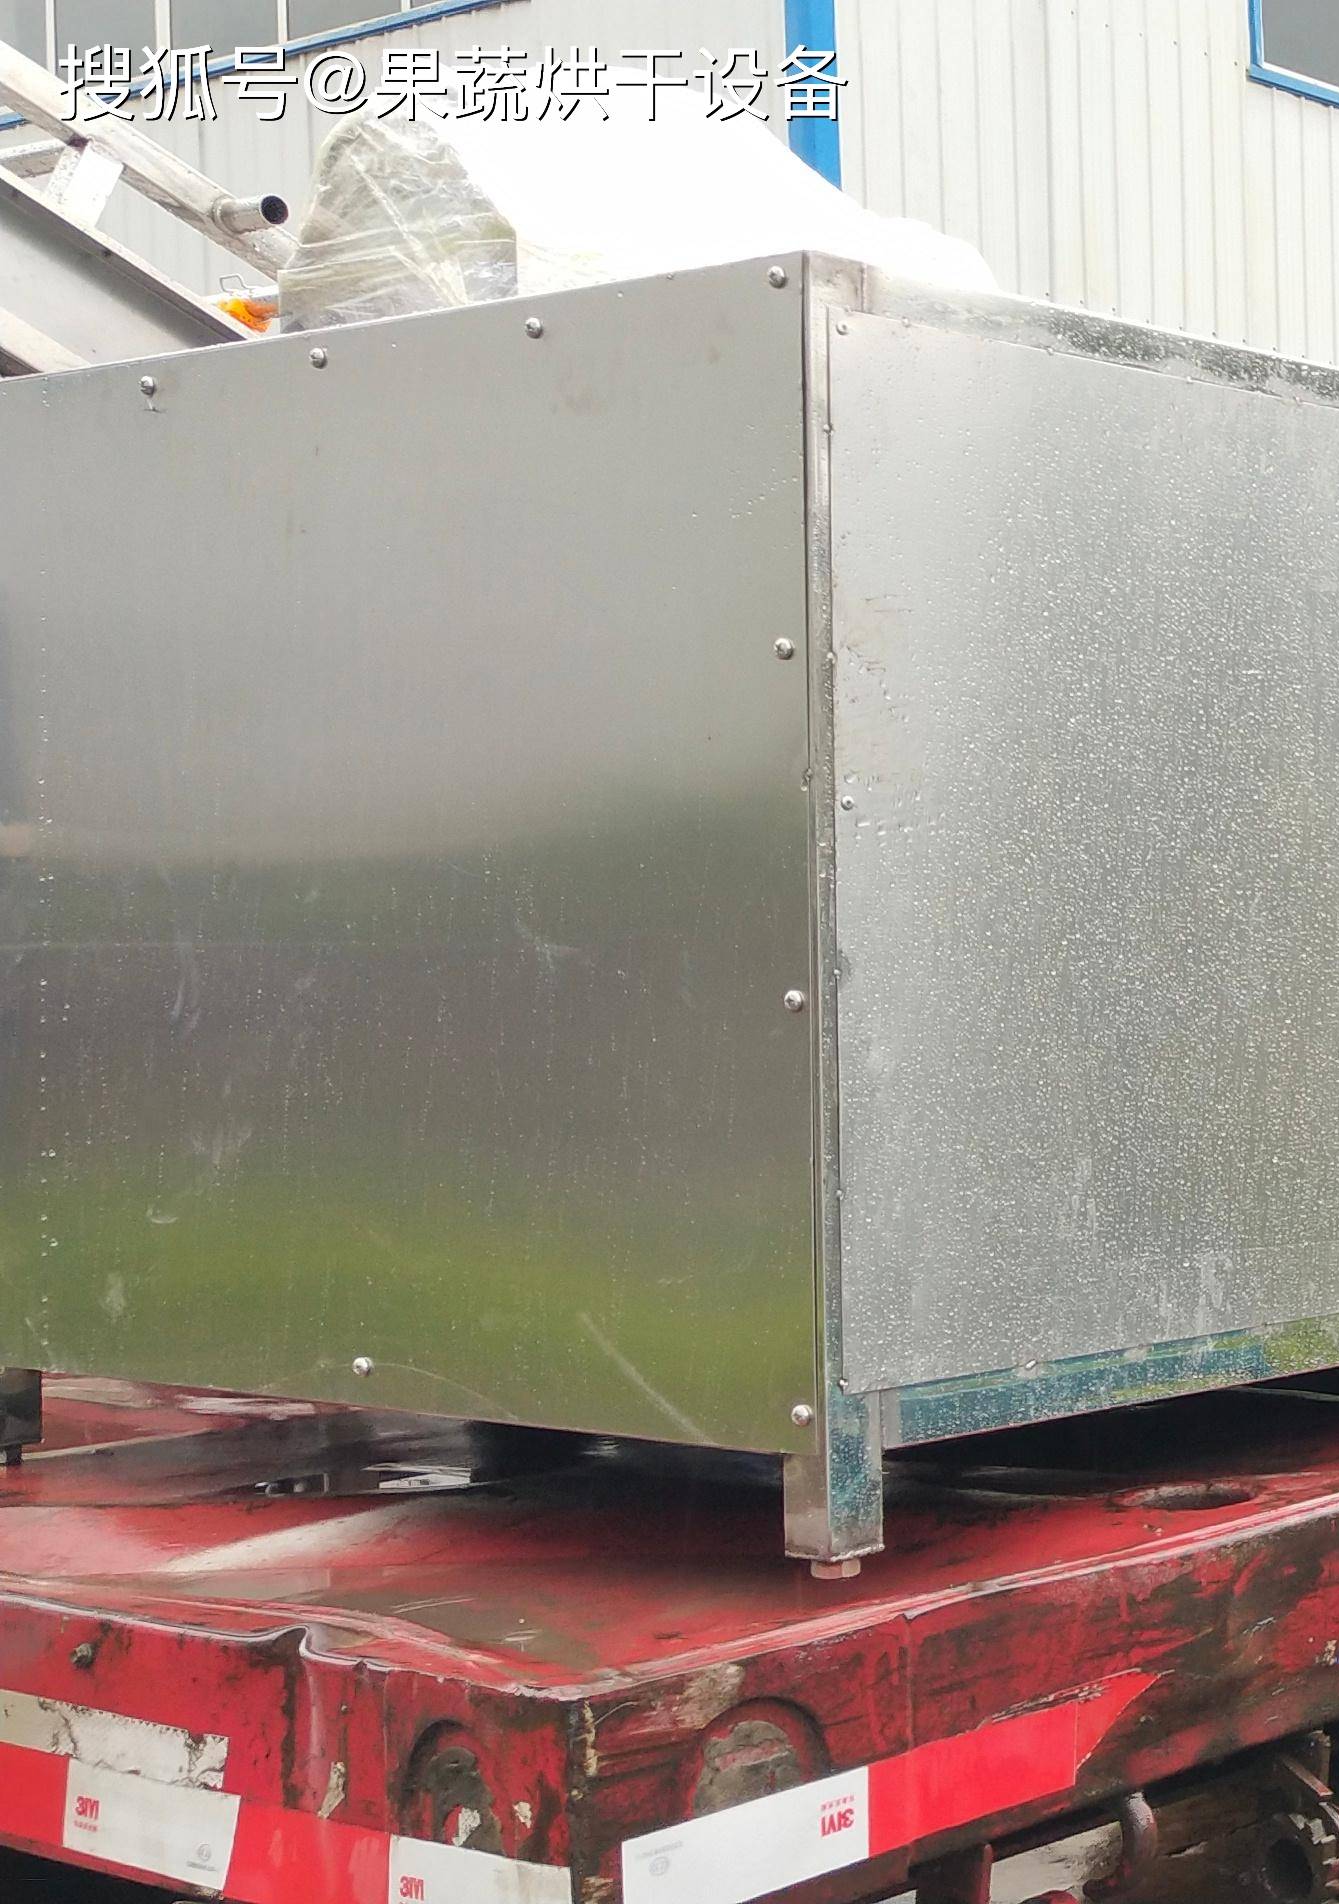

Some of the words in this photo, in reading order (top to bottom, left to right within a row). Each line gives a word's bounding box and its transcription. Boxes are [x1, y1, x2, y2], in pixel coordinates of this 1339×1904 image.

[75, 1796, 100, 1821] 3M
[820, 1808, 855, 1838] 3M
[400, 1875, 425, 1901] 3M
